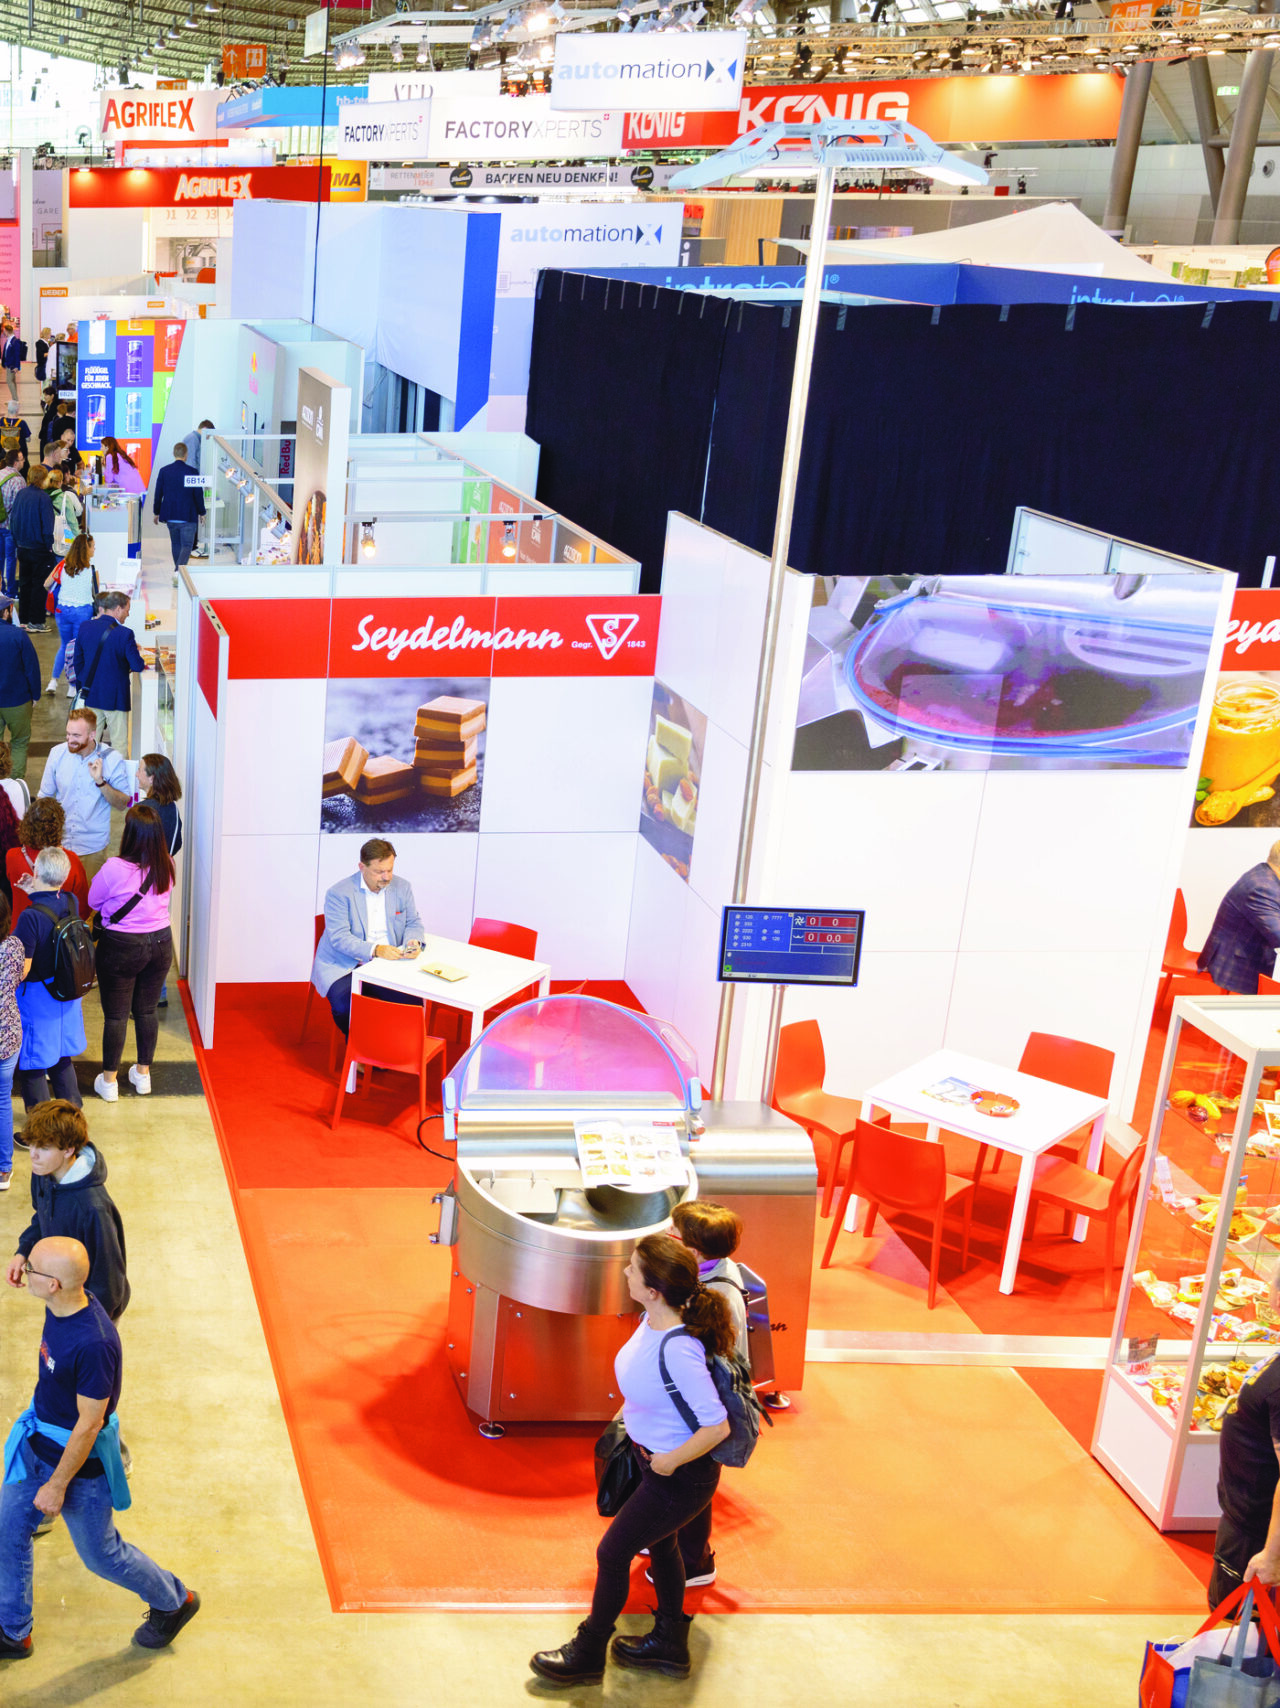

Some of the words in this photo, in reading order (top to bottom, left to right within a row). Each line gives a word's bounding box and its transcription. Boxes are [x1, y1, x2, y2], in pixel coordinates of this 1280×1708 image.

[102, 97, 195, 133] AGRIFLEX
[343, 121, 419, 143] FACTORYXPERTS
[444, 119, 602, 140] FACTORYXPERTS
[174, 172, 253, 201] AGRIFLEX
[485, 173, 534, 184] BACKEN
[536, 172, 561, 183] NEU
[564, 171, 618, 183] DENKEN!
[280, 454, 290, 475] Red
[351, 614, 564, 661] Seydelmann
[571, 641, 593, 650] Gegr.
